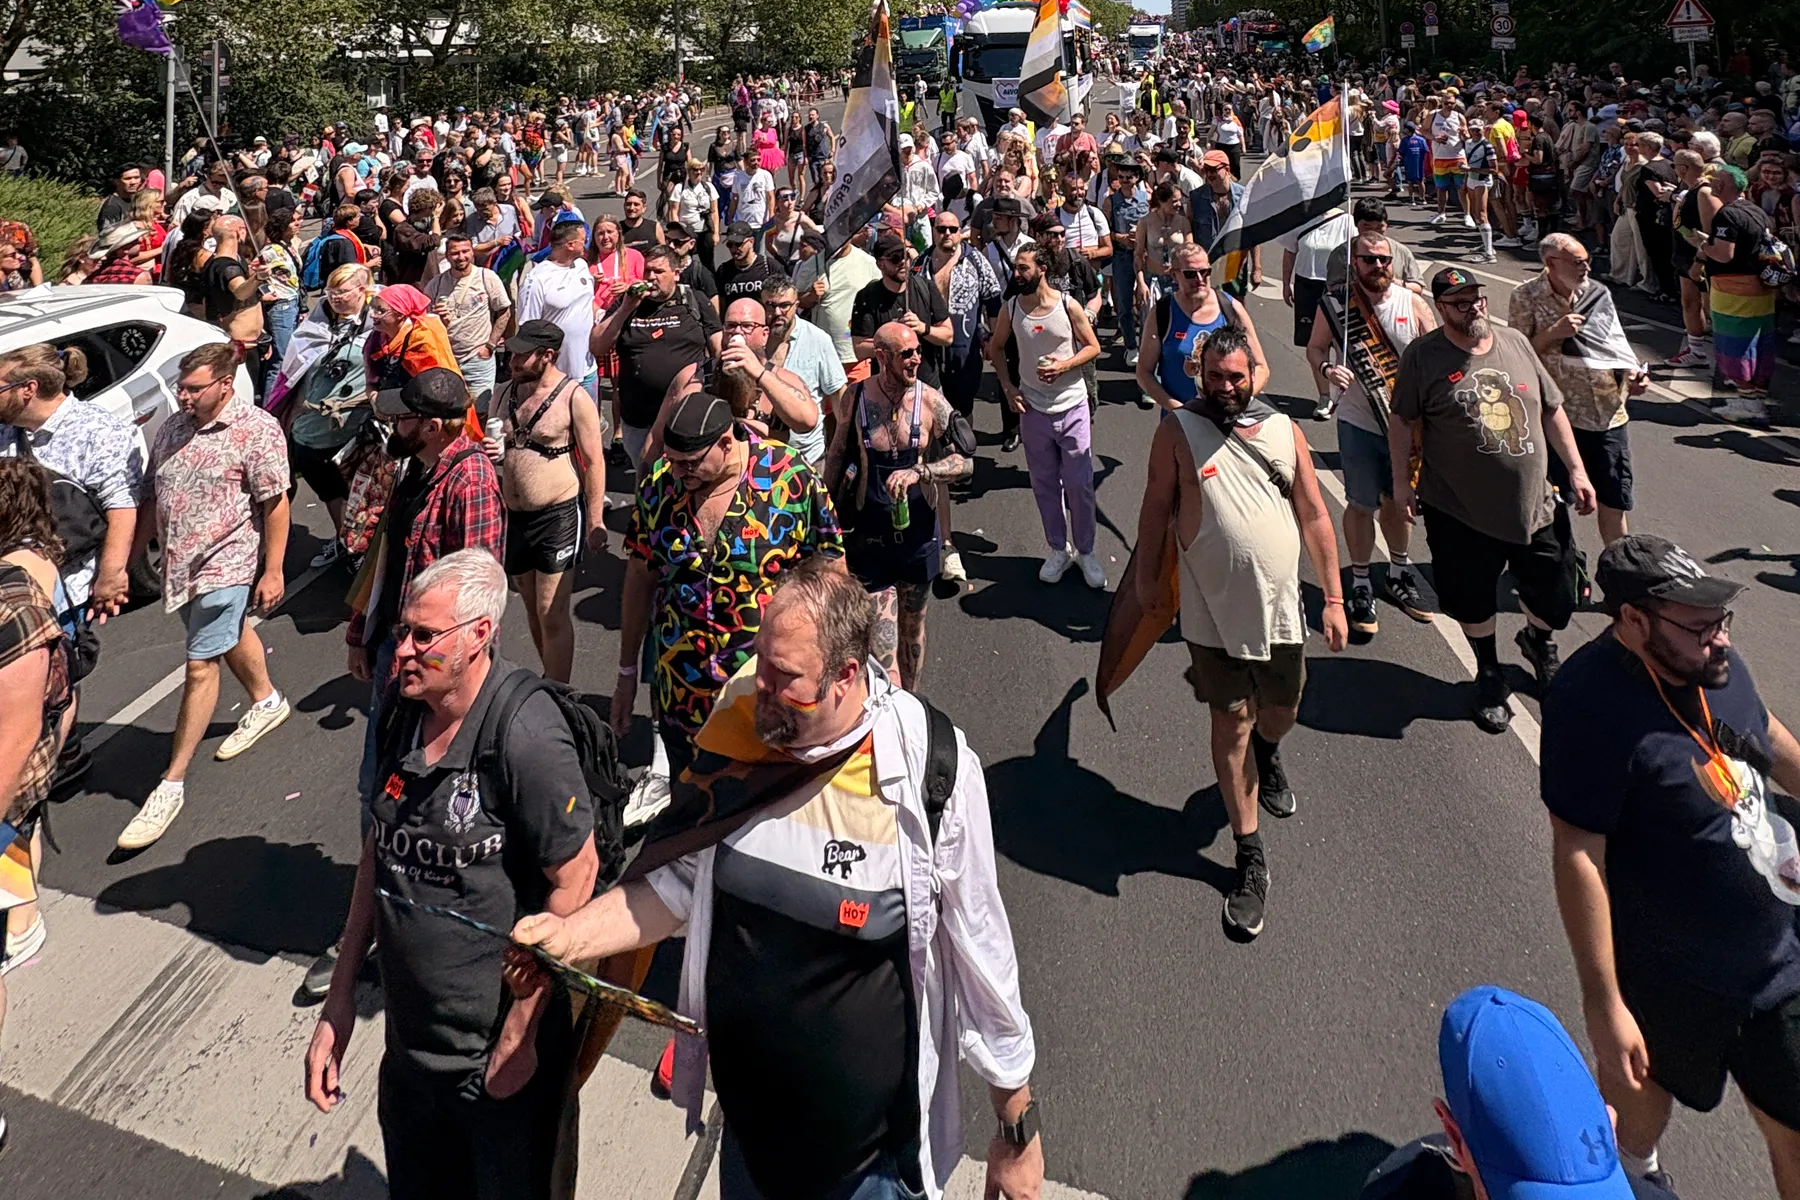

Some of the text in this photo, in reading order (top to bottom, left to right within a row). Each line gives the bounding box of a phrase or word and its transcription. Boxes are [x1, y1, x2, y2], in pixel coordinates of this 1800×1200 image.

[1496, 19, 1509, 31] 30
[724, 280, 763, 296] BATOR
[415, 833, 503, 869] CLUB
[826, 842, 861, 864] Bear
[843, 906, 866, 921] HOT
